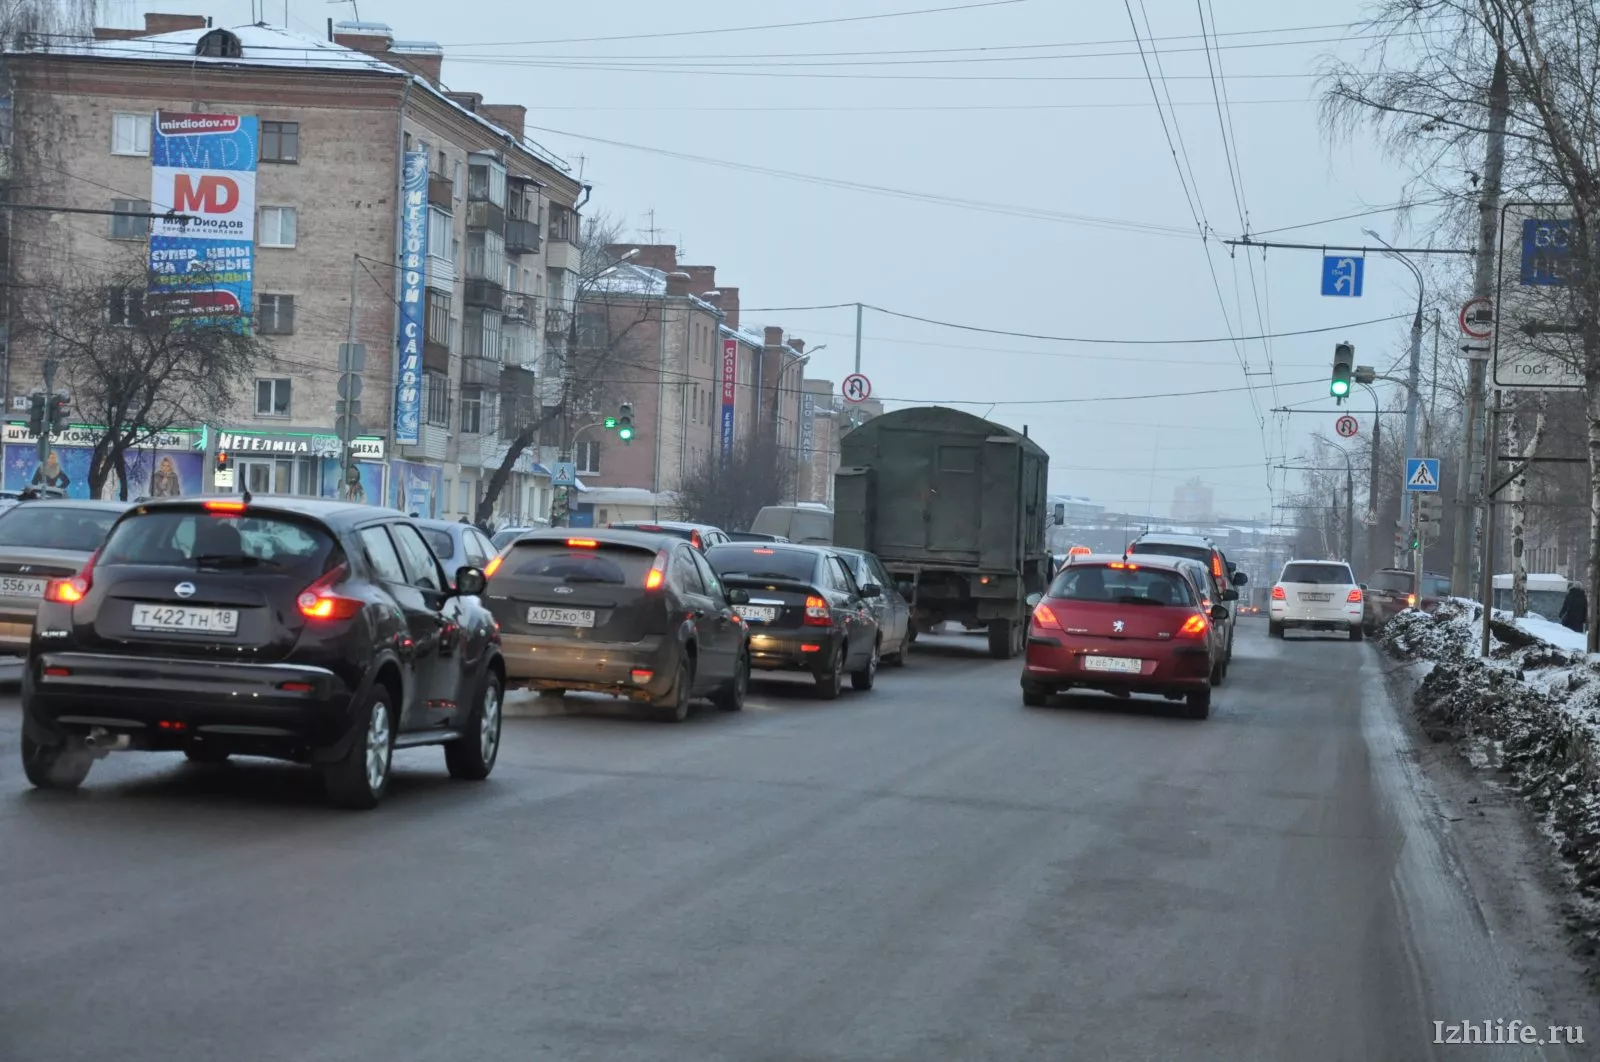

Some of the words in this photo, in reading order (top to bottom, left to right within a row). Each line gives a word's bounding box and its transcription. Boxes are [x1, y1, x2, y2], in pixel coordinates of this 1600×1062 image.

[161, 118, 236, 129] mirdiodov.ru
[174, 173, 239, 213] MD
[162, 226, 200, 234] ТОРГВАЯ
[151, 249, 198, 261] СУПЕР
[206, 246, 251, 259] ЦЕНЫ
[404, 190, 422, 303] МЕХОВОЙ
[402, 322, 418, 402] САЛОН
[218, 432, 308, 453] МЕТЕЛИЦА
